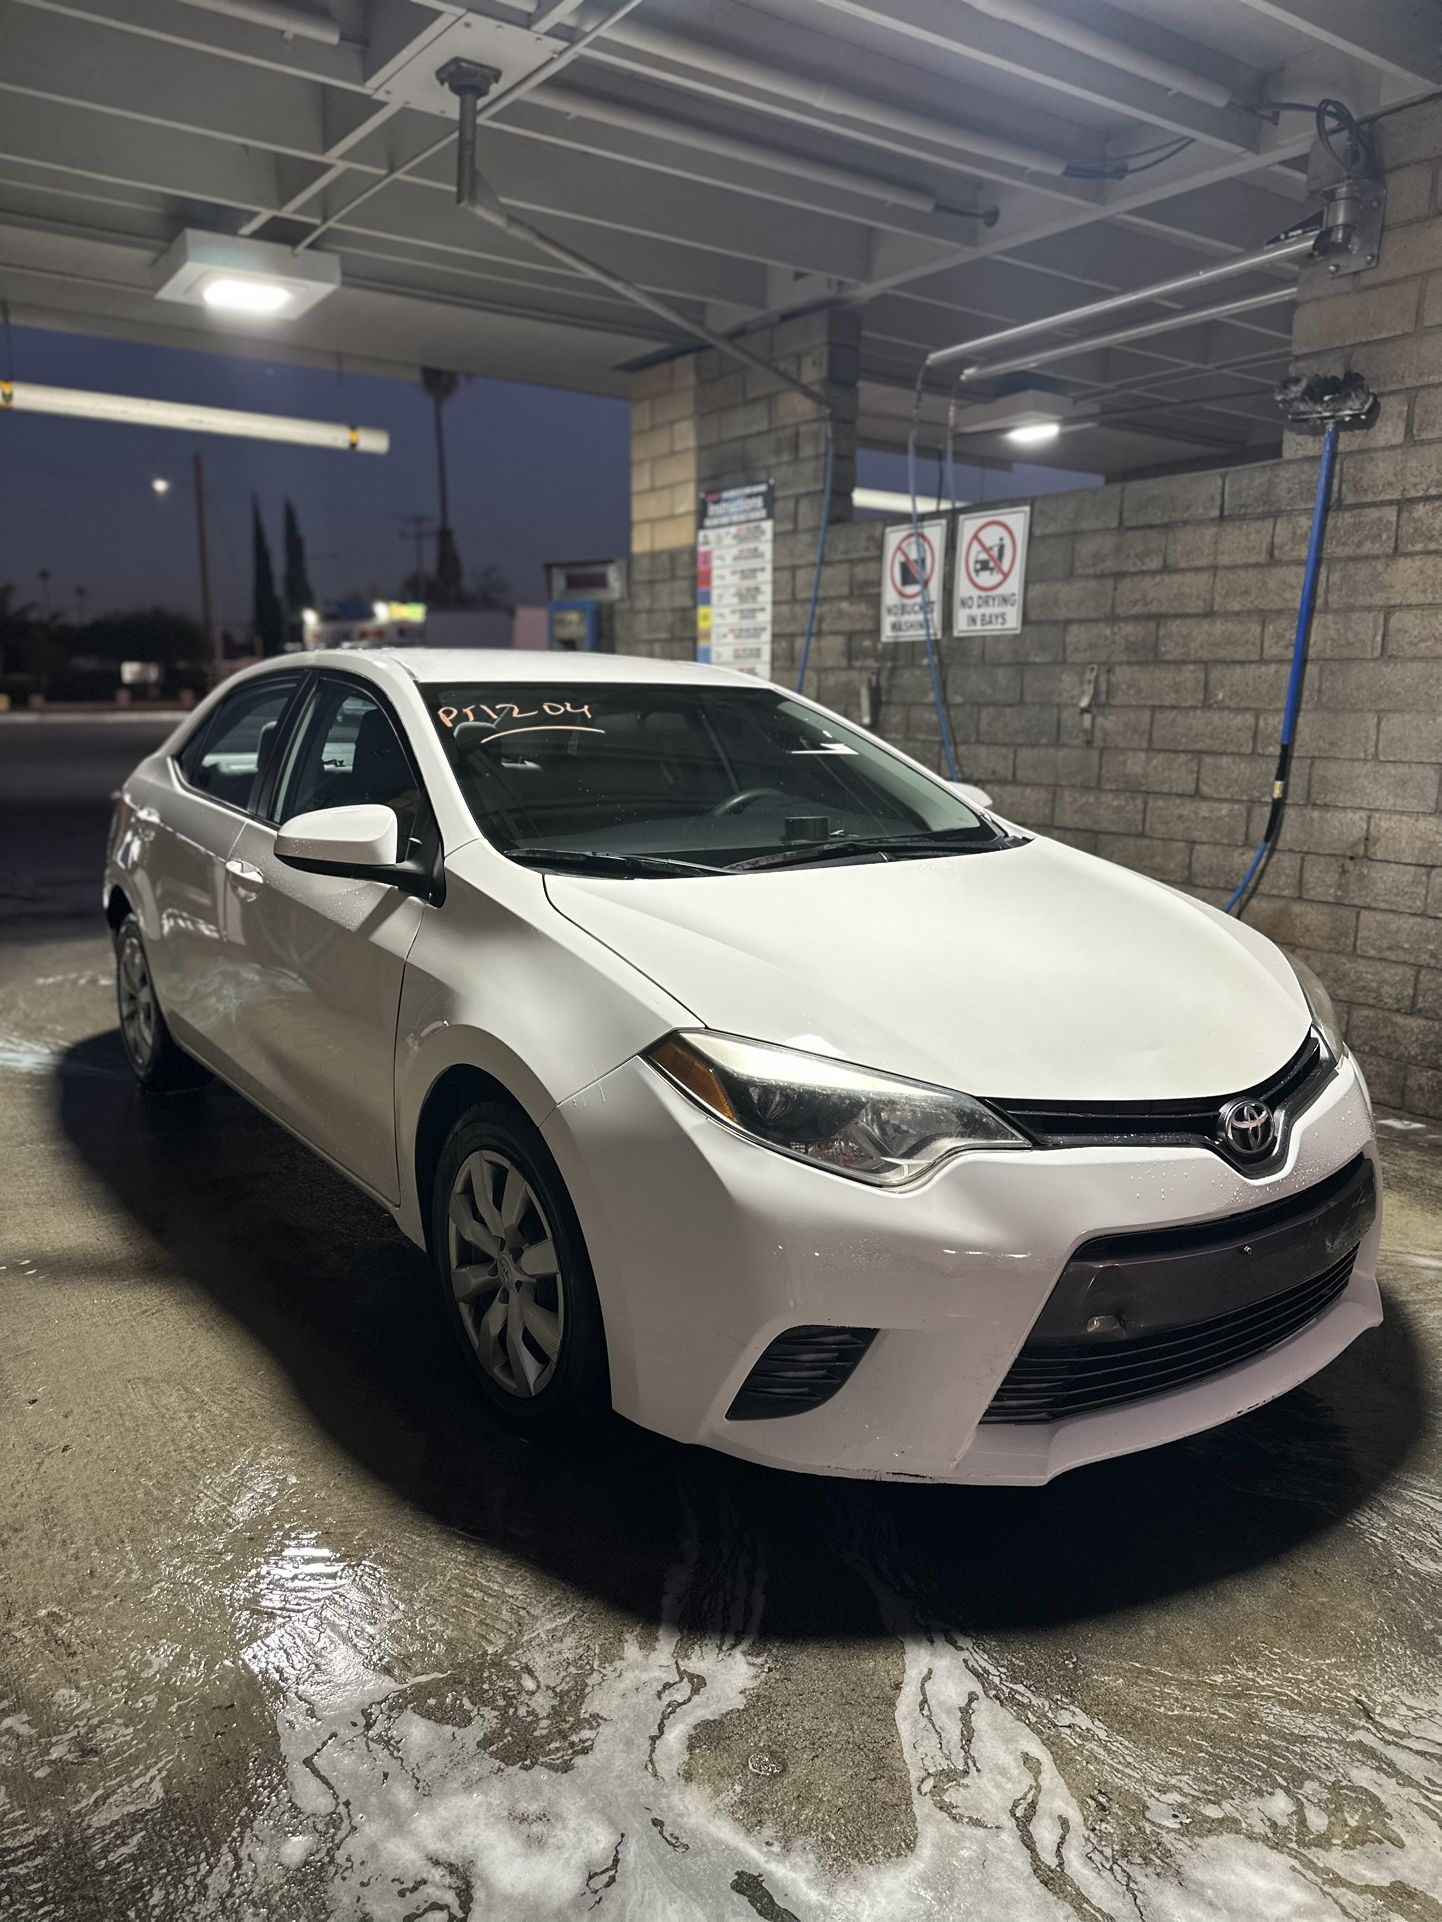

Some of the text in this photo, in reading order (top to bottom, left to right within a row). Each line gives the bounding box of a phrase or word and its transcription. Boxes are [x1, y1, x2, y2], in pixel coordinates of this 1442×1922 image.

[960, 592, 1017, 609] NO DRYING
[886, 603, 899, 617] NO
[890, 618, 931, 632] WASHIN
[966, 611, 1007, 627] IN BAYS
